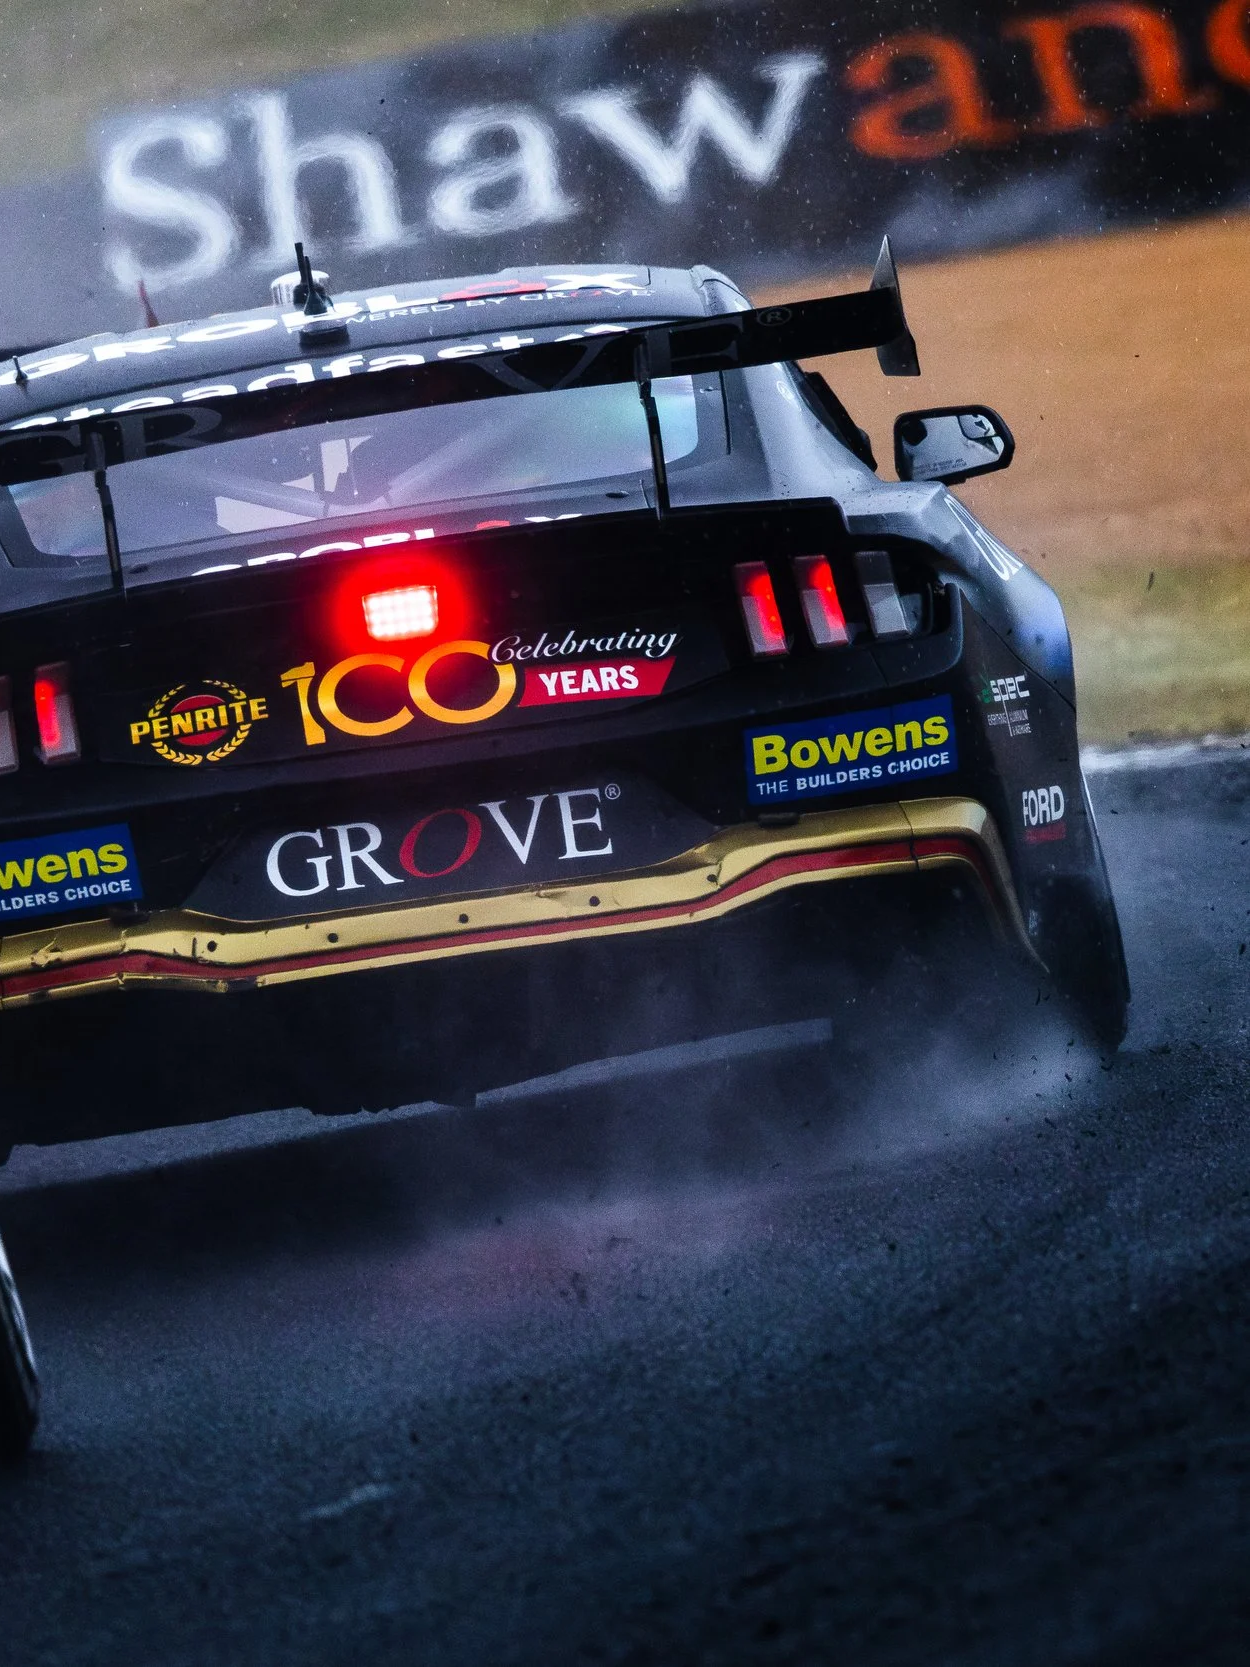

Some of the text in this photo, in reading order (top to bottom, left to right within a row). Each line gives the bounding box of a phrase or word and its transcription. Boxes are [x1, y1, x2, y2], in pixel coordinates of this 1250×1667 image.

[102, 0, 1250, 292] Shaw an
[287, 302, 456, 334] PWERED
[491, 627, 680, 664] Celebrating
[538, 664, 639, 697] YEARS
[130, 697, 269, 745] PENRITE
[751, 715, 950, 776] Bowens
[756, 751, 950, 796] THE BUILDERS CHOICE
[1021, 785, 1065, 827] FORD
[63, 878, 133, 902] CHOICE
